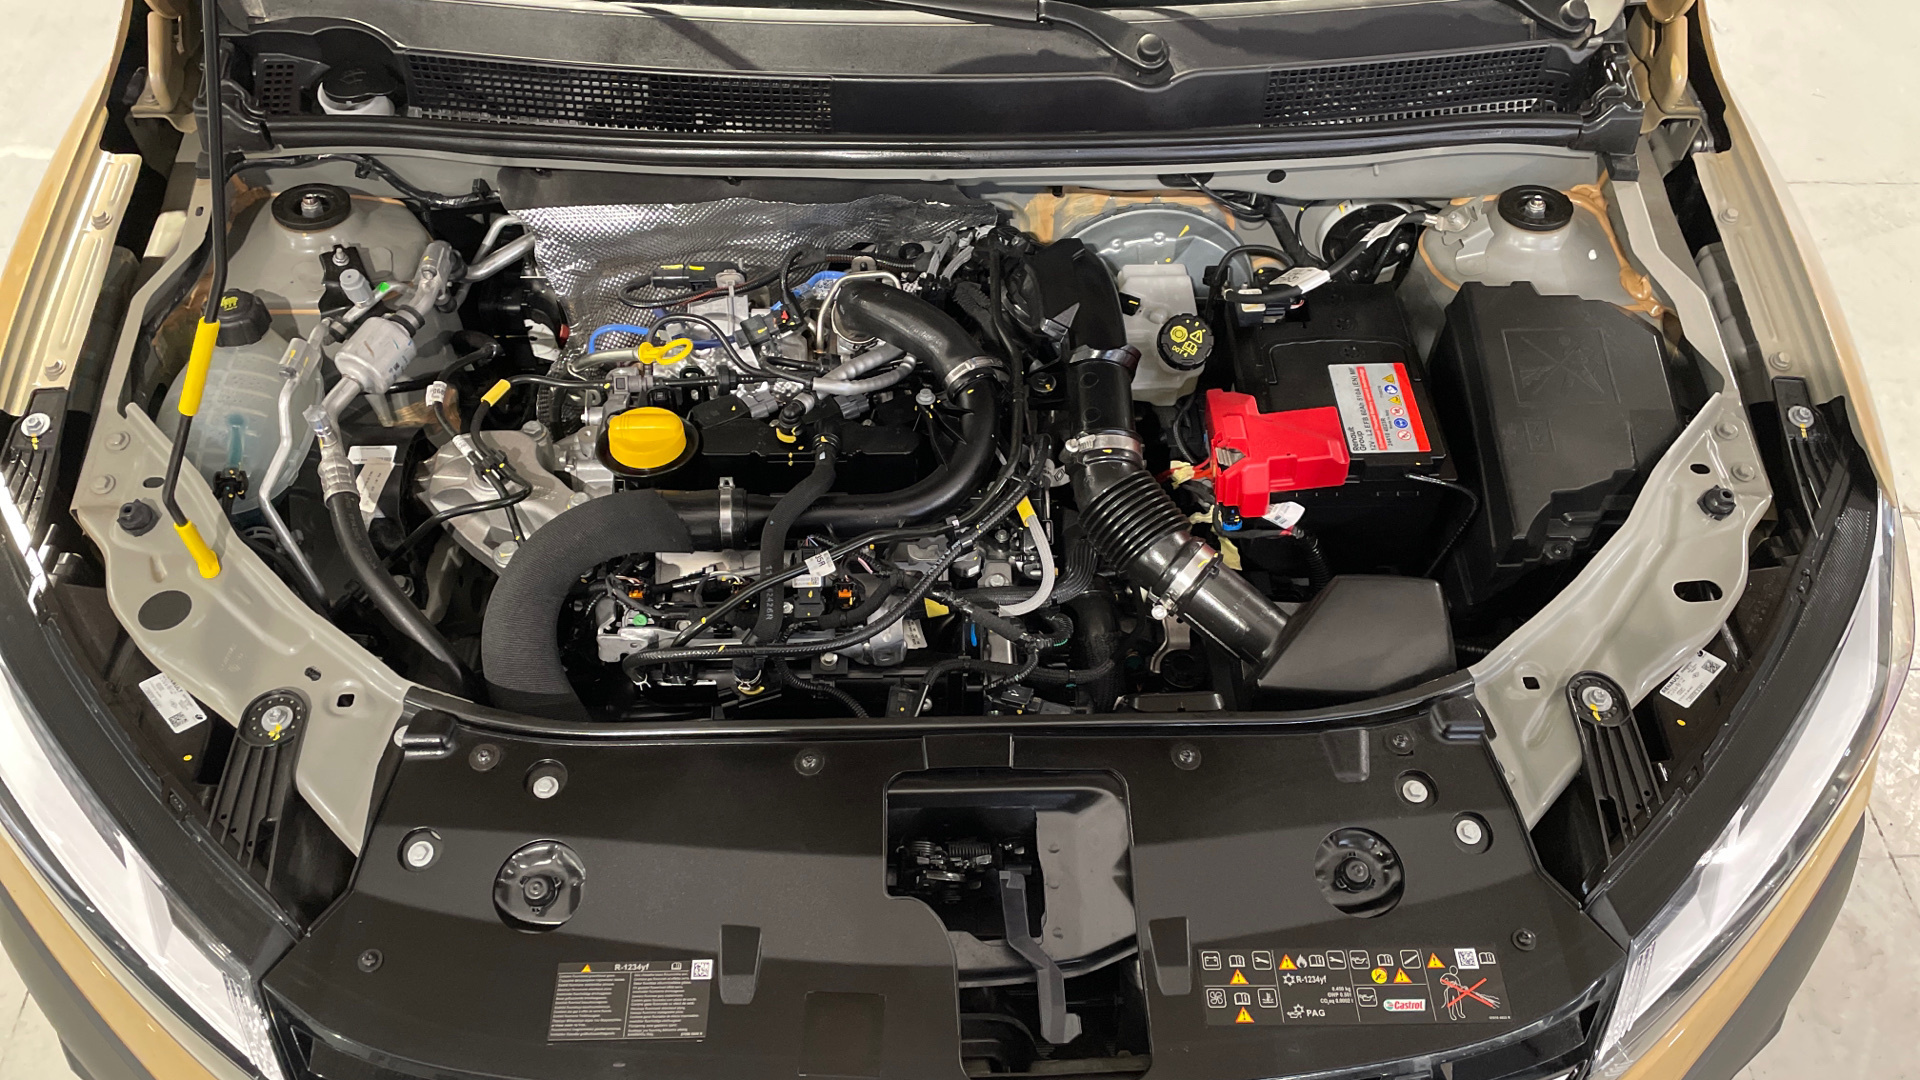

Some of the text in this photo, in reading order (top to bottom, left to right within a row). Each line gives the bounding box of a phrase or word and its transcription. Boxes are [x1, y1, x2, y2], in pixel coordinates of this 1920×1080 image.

[1347, 426, 1360, 451] Renault
[1356, 430, 1367, 451] Group
[614, 962, 650, 973] R-1234yf
[1295, 974, 1327, 985] R-1234yf
[1394, 1000, 1423, 1010] Castrol
[1306, 1009, 1326, 1017] PAG
